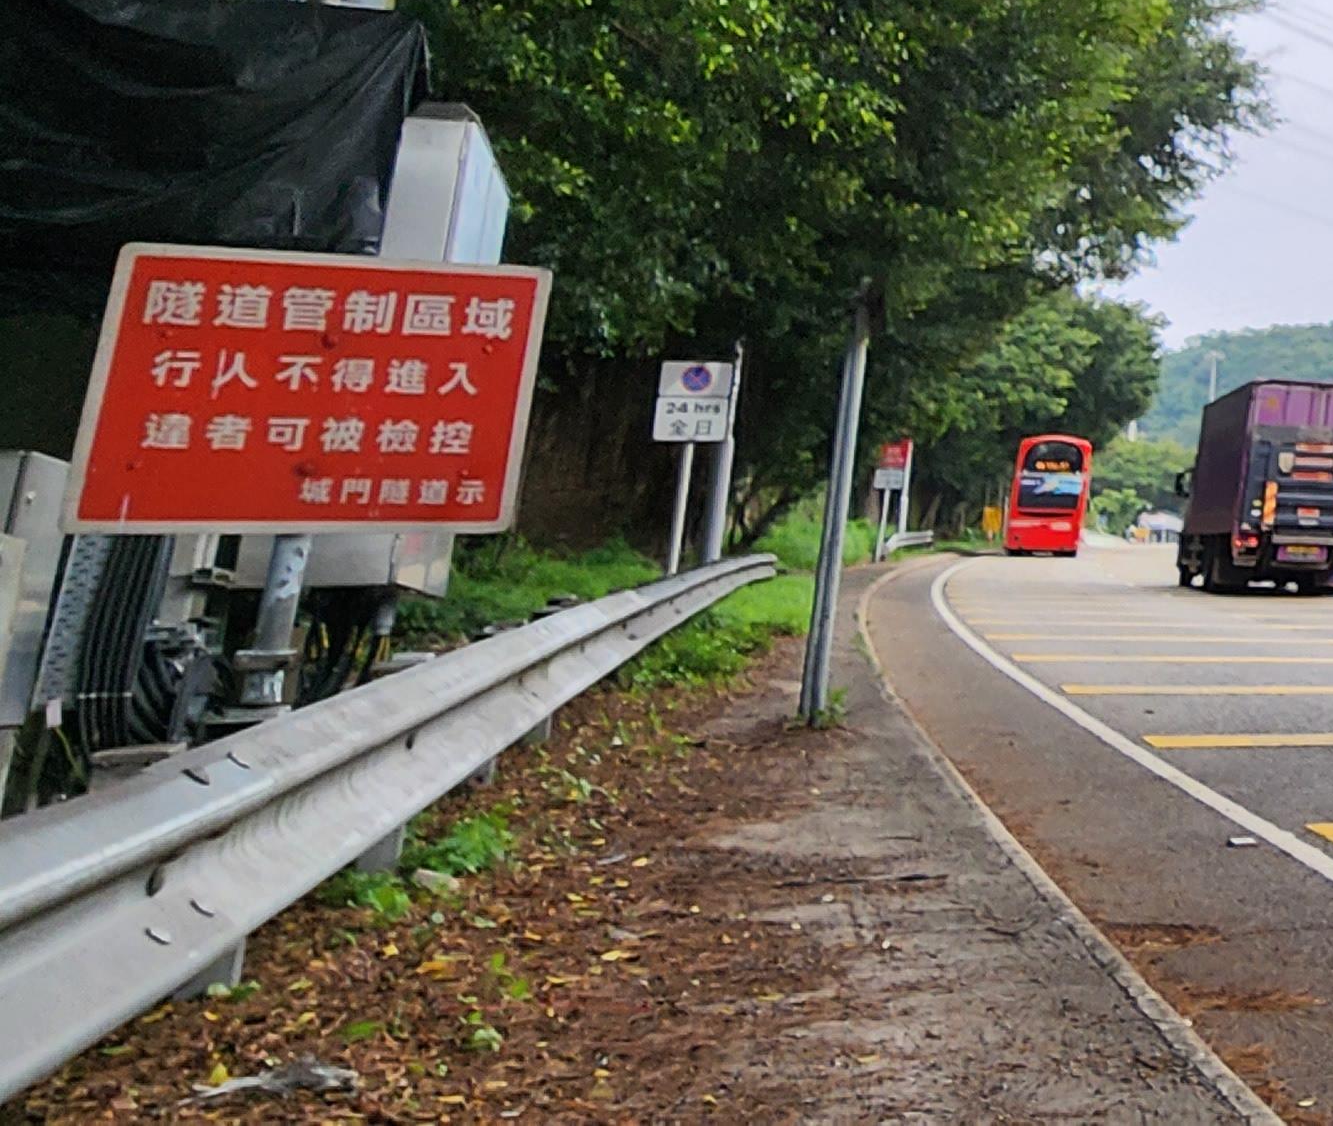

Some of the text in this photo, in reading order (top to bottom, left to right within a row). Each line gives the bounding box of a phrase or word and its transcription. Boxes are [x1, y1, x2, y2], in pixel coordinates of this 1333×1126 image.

[142, 279, 515, 341] 隧道管制區域
[151, 349, 478, 395] 行人不得進入
[665, 401, 720, 415] 24 hrs
[141, 413, 474, 455] 違者可被檢控
[670, 419, 712, 435] 全日
[300, 476, 486, 506] 城門隧道示
